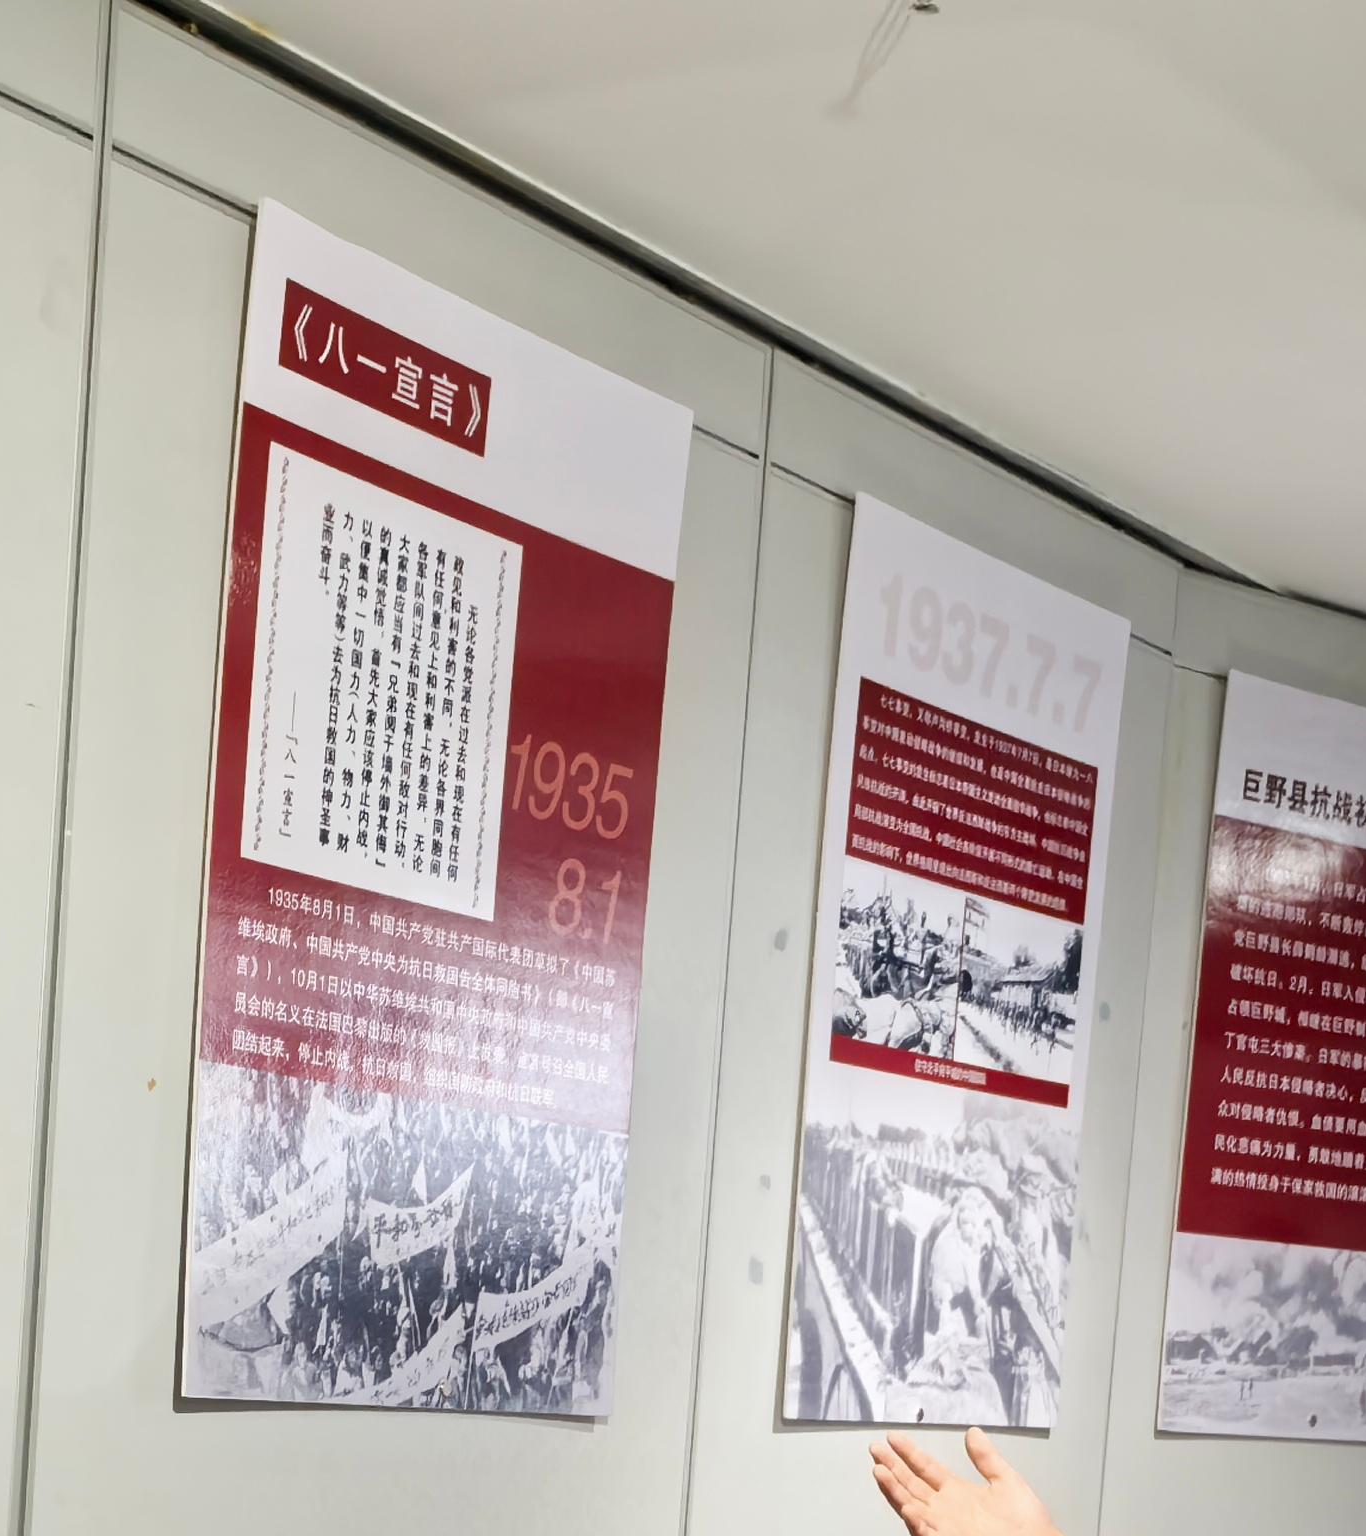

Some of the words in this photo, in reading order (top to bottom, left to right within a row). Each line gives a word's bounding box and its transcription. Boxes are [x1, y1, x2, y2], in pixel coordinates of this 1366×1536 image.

[293, 303, 481, 439] 《八一宣言》
[881, 573, 1102, 733] 1937.7.7
[511, 733, 634, 840] 1935
[549, 857, 622, 945] 8.1
